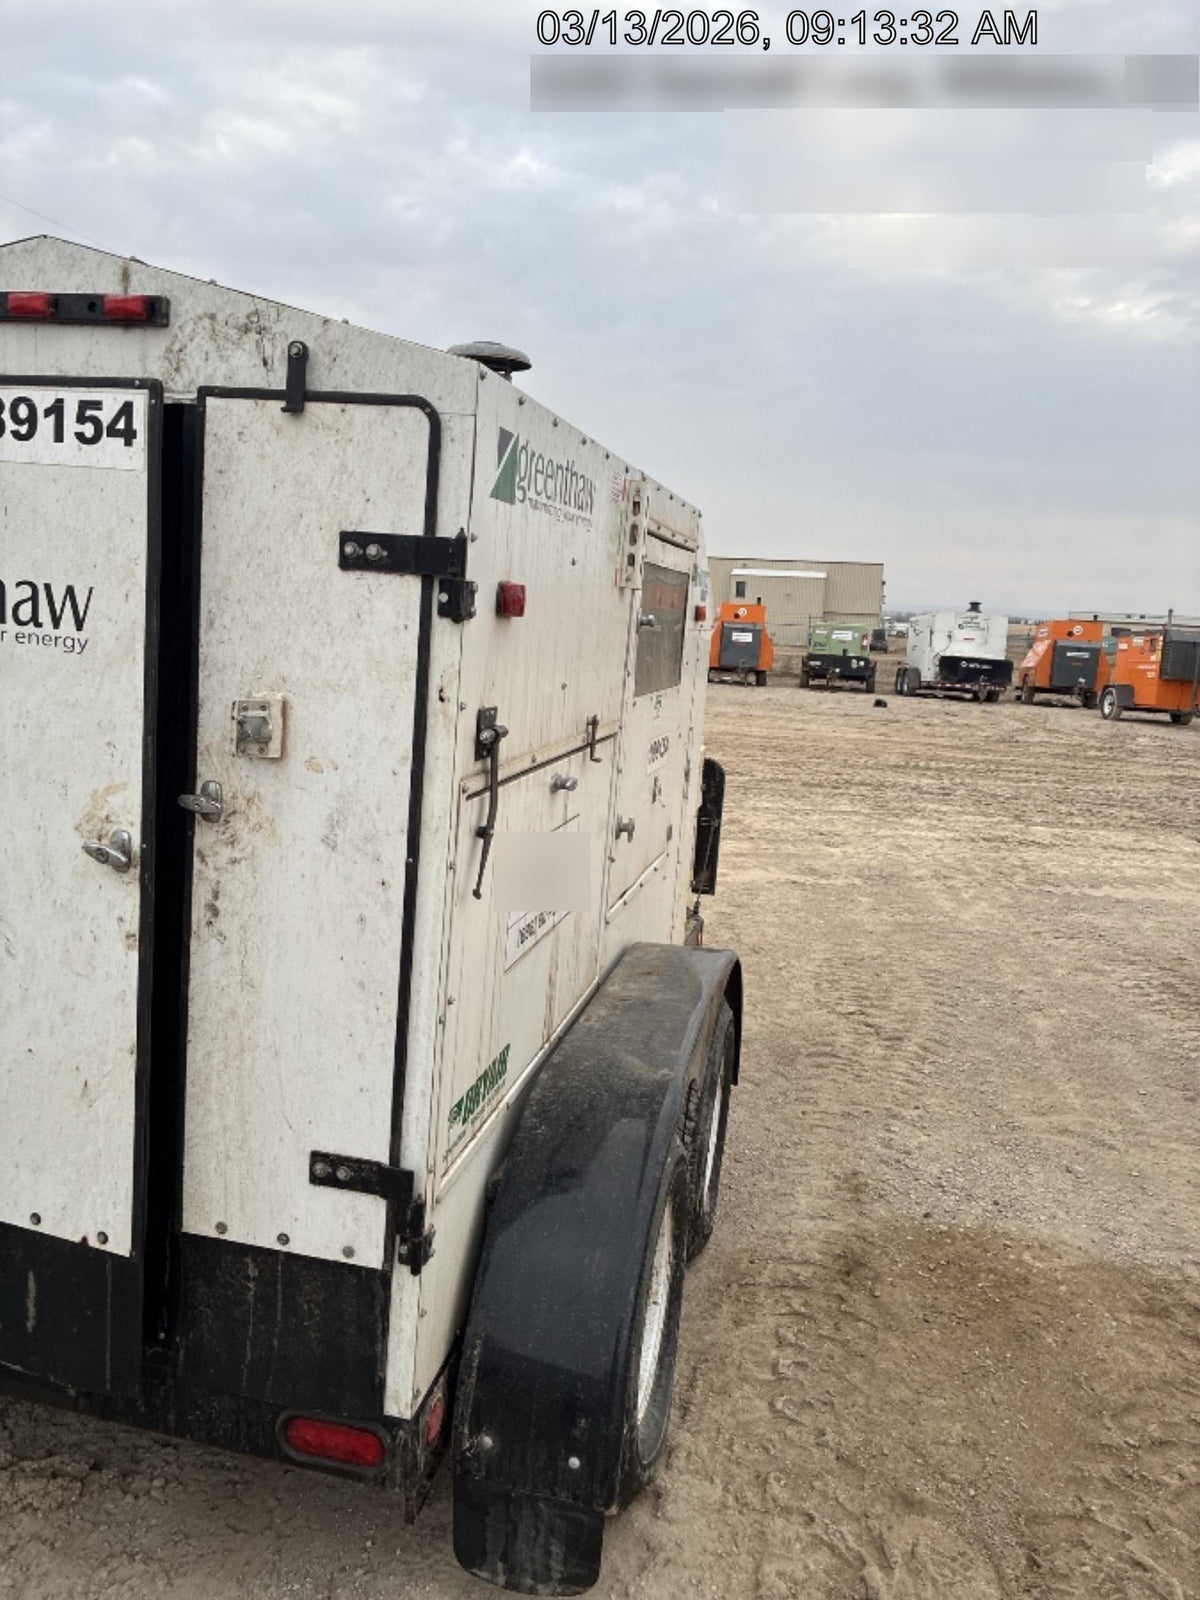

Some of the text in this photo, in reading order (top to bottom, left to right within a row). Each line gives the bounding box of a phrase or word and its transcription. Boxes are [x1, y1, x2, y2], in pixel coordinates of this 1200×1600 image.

[0, 396, 137, 447] 9154
[0, 578, 94, 632] aw
[15, 630, 89, 655] energy
